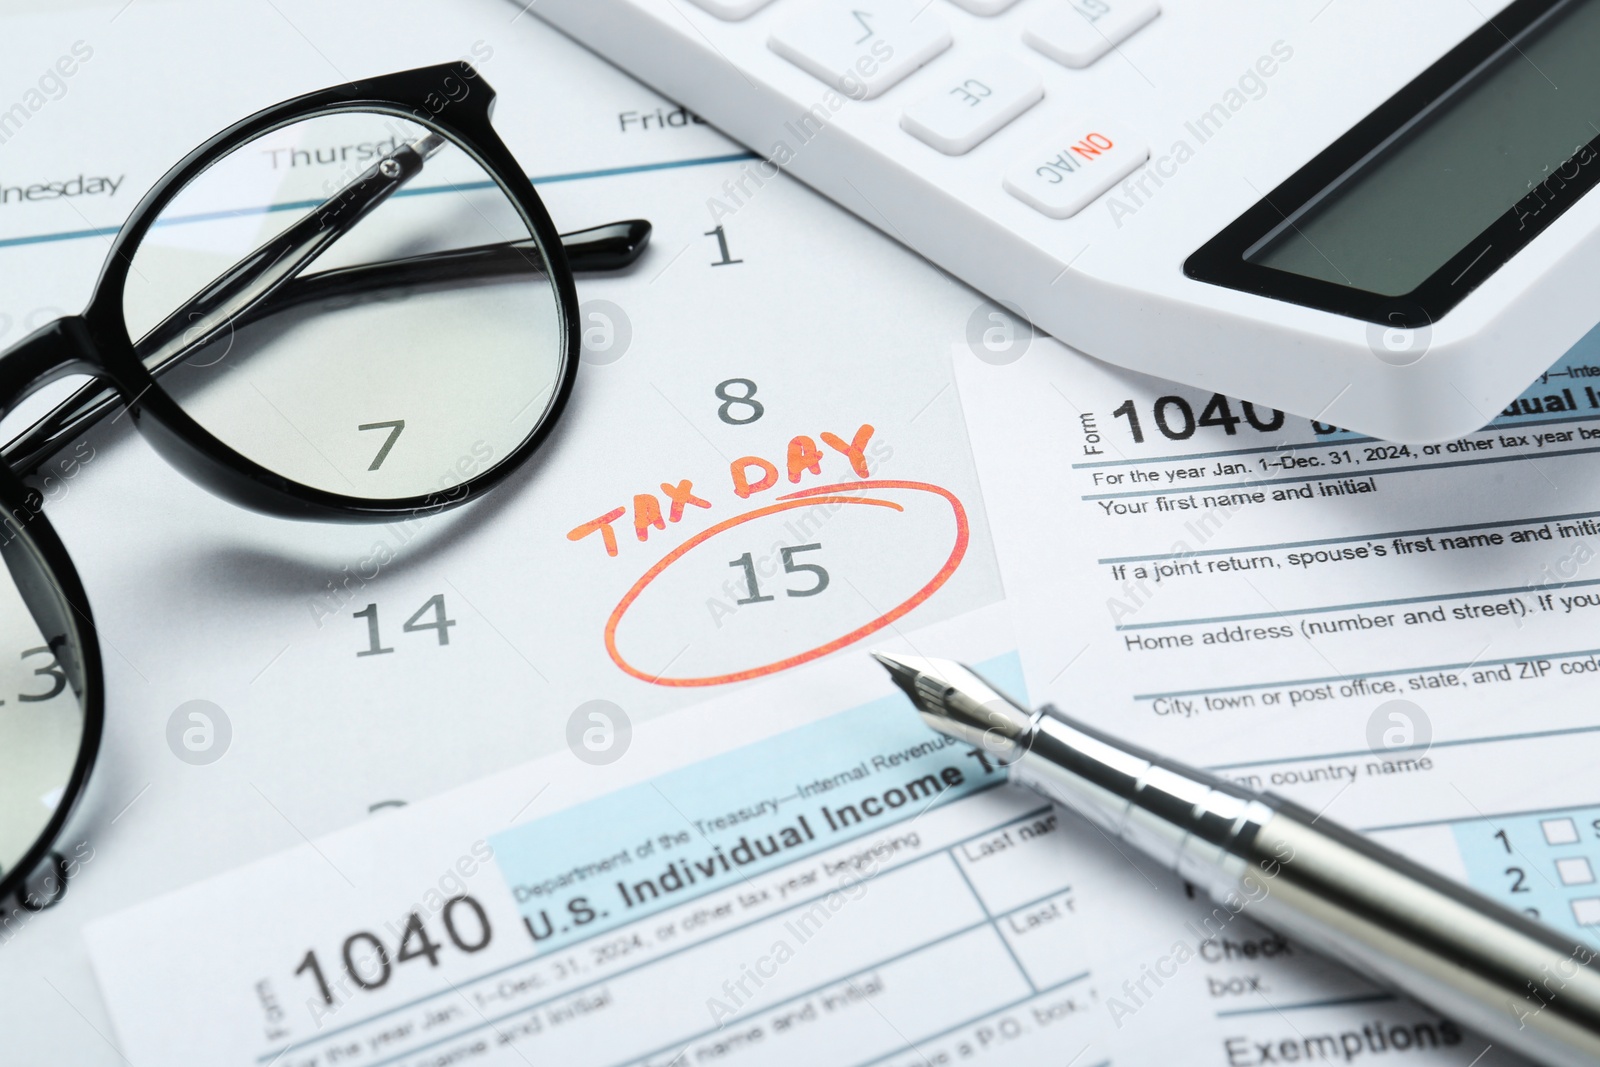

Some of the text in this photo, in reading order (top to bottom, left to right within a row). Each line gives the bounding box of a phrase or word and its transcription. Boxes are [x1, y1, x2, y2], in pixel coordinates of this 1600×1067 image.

[950, 79, 992, 107] CE
[262, 136, 418, 169] Thursd
[704, 225, 743, 267] 1
[715, 378, 765, 425] 8
[1111, 392, 1286, 444] 1040
[358, 419, 405, 471] 7
[1080, 412, 1103, 456] Form
[1093, 471, 1124, 486] For
[1130, 467, 1160, 482] the
[1165, 467, 1206, 486] year
[1212, 461, 1252, 477] Jan.
[1331, 450, 1361, 466] 31,
[1366, 444, 1419, 463] 2024,
[1423, 443, 1442, 456] or
[1448, 436, 1494, 454] other
[1499, 432, 1527, 448] tax
[1534, 428, 1575, 447] year
[566, 424, 875, 557] TAX DAY
[1098, 477, 1377, 516] Your first name and initial
[729, 543, 830, 606] 15
[1112, 563, 1126, 582] If
[1134, 566, 1148, 580] a
[1154, 558, 1203, 583] joint
[1207, 554, 1282, 573] return,
[1392, 536, 1437, 555] first
[1439, 532, 1504, 552] name
[1509, 524, 1552, 544] and
[352, 593, 456, 658] 14
[1125, 631, 1194, 652] Home
[1201, 623, 1294, 646] address
[1301, 612, 1395, 640] (number
[1404, 605, 1446, 626] and
[1452, 597, 1532, 620] street).
[1538, 593, 1554, 612] If
[1153, 697, 1199, 718] City,
[1204, 693, 1256, 712] town
[1261, 692, 1282, 706] or
[1288, 682, 1335, 707] post
[1340, 678, 1403, 699] office,
[1408, 671, 1467, 691] state,
[1472, 664, 1512, 685] and
[1515, 659, 1552, 681] ZIP
[1270, 763, 1358, 786] country
[1366, 756, 1434, 777] name
[522, 895, 610, 943] U.S.
[616, 814, 816, 909] Individual
[820, 763, 965, 832] Income
[961, 830, 1016, 863] Last
[1494, 829, 1512, 854] 1
[512, 848, 633, 904] Department
[635, 839, 655, 860] of
[659, 828, 691, 850] the
[774, 871, 819, 899] year
[1505, 866, 1530, 893] 2
[1007, 903, 1063, 936] Last
[294, 894, 493, 1006] 1040
[1200, 933, 1292, 964] Check
[1205, 973, 1271, 998] box.
[1222, 1016, 1464, 1067] Exemptions
